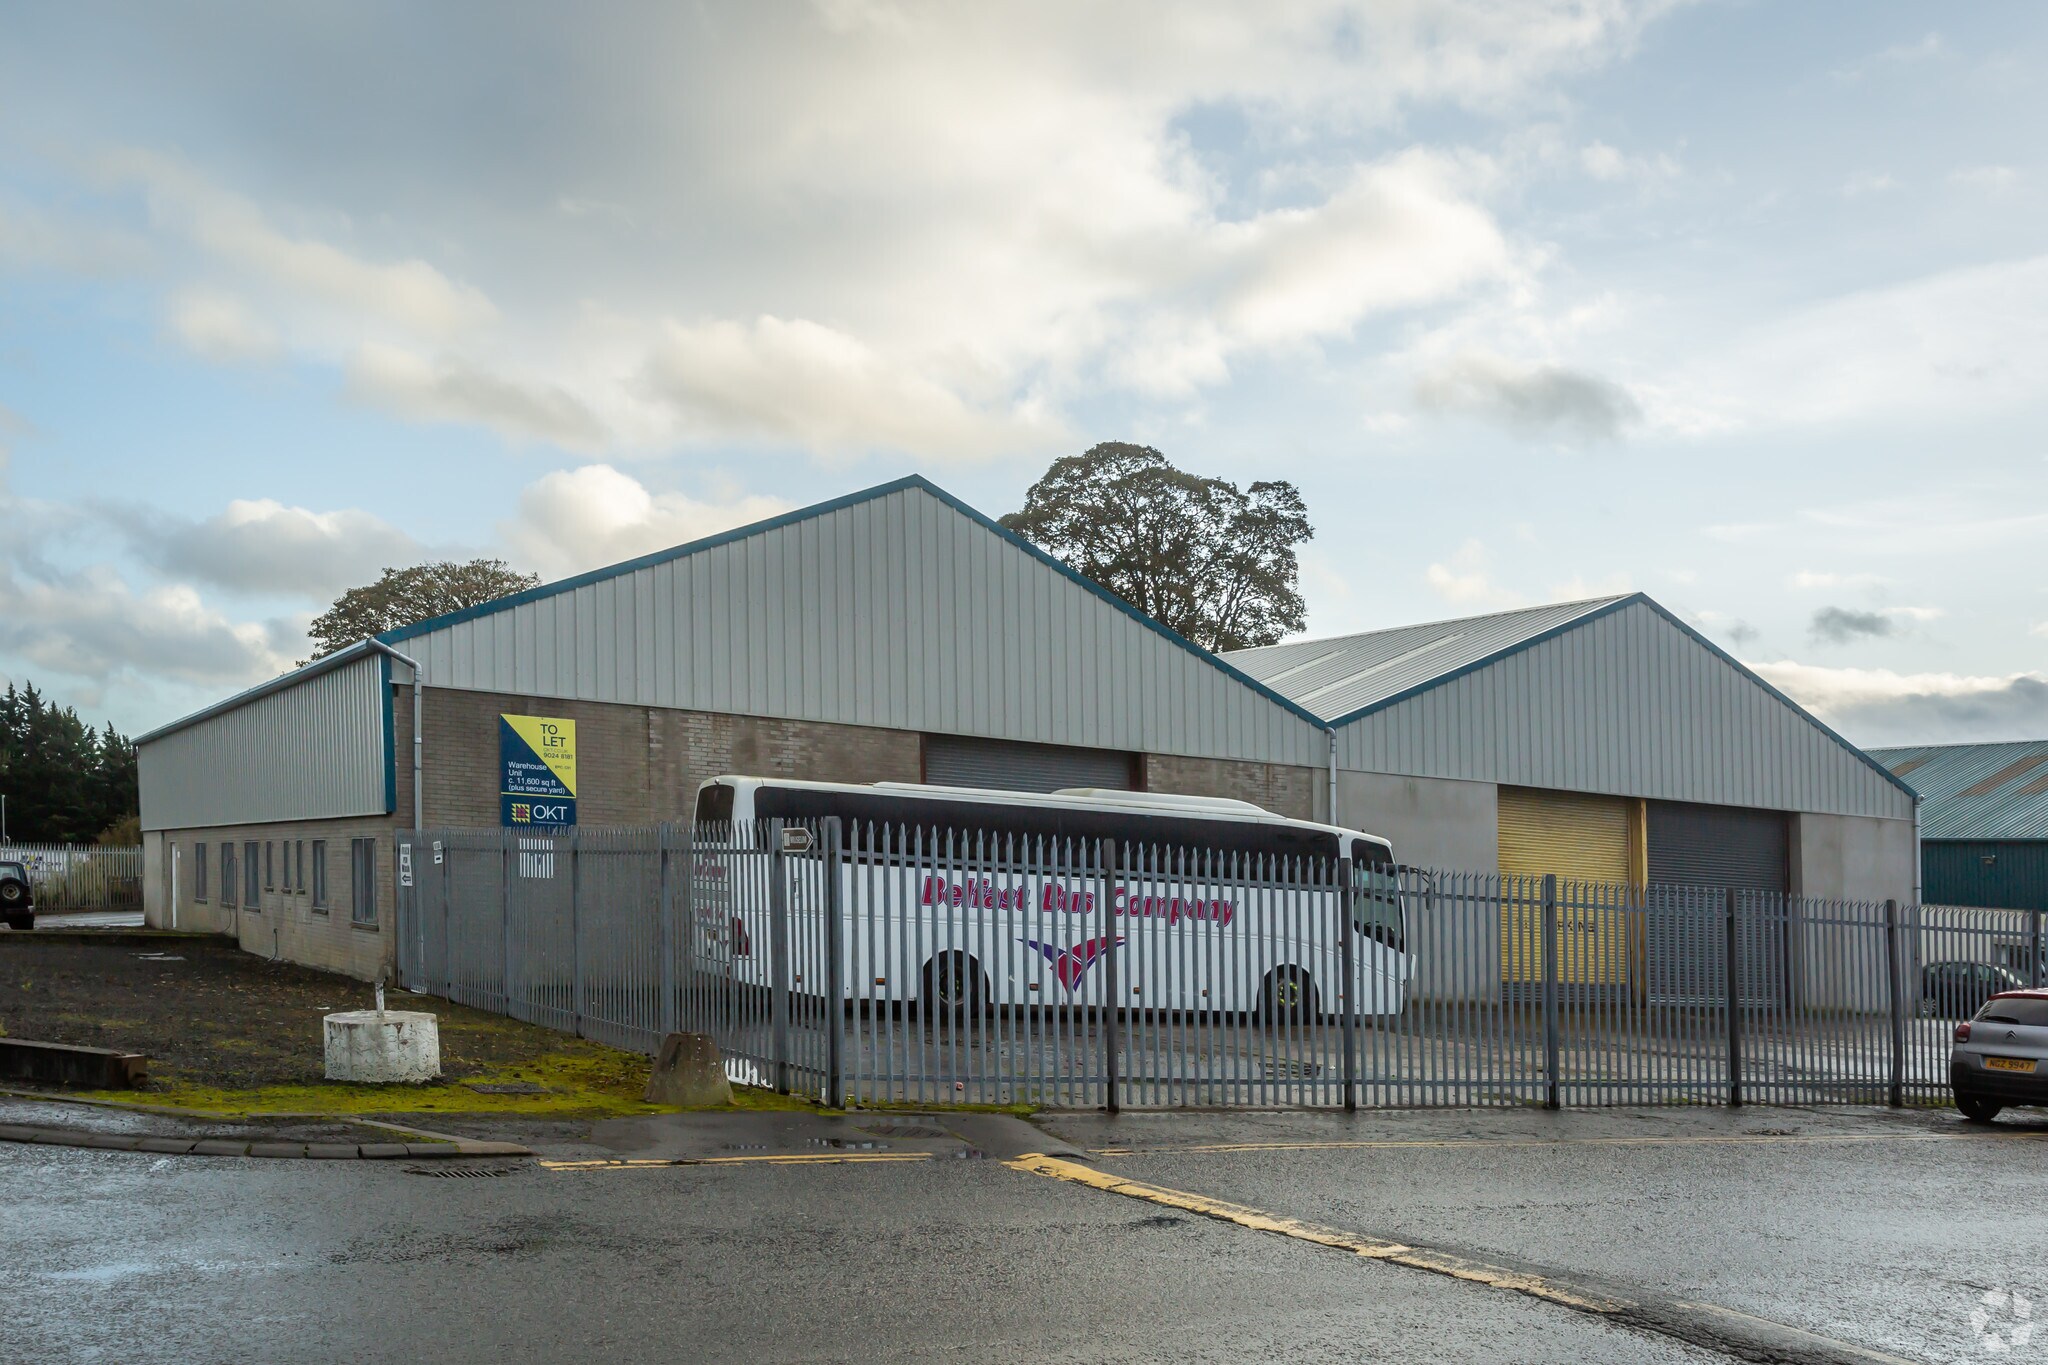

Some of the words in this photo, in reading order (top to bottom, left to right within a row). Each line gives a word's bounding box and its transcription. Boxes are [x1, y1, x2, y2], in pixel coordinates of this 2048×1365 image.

[540, 724, 558, 735] TO
[543, 736, 566, 747] LET
[508, 761, 548, 771] Warehouse
[508, 769, 523, 777] Unit
[517, 777, 540, 785] 11,600
[508, 784, 525, 792] (plus
[548, 787, 566, 795] yard)
[533, 805, 568, 820] OKT
[1042, 882, 1095, 915] Bus
